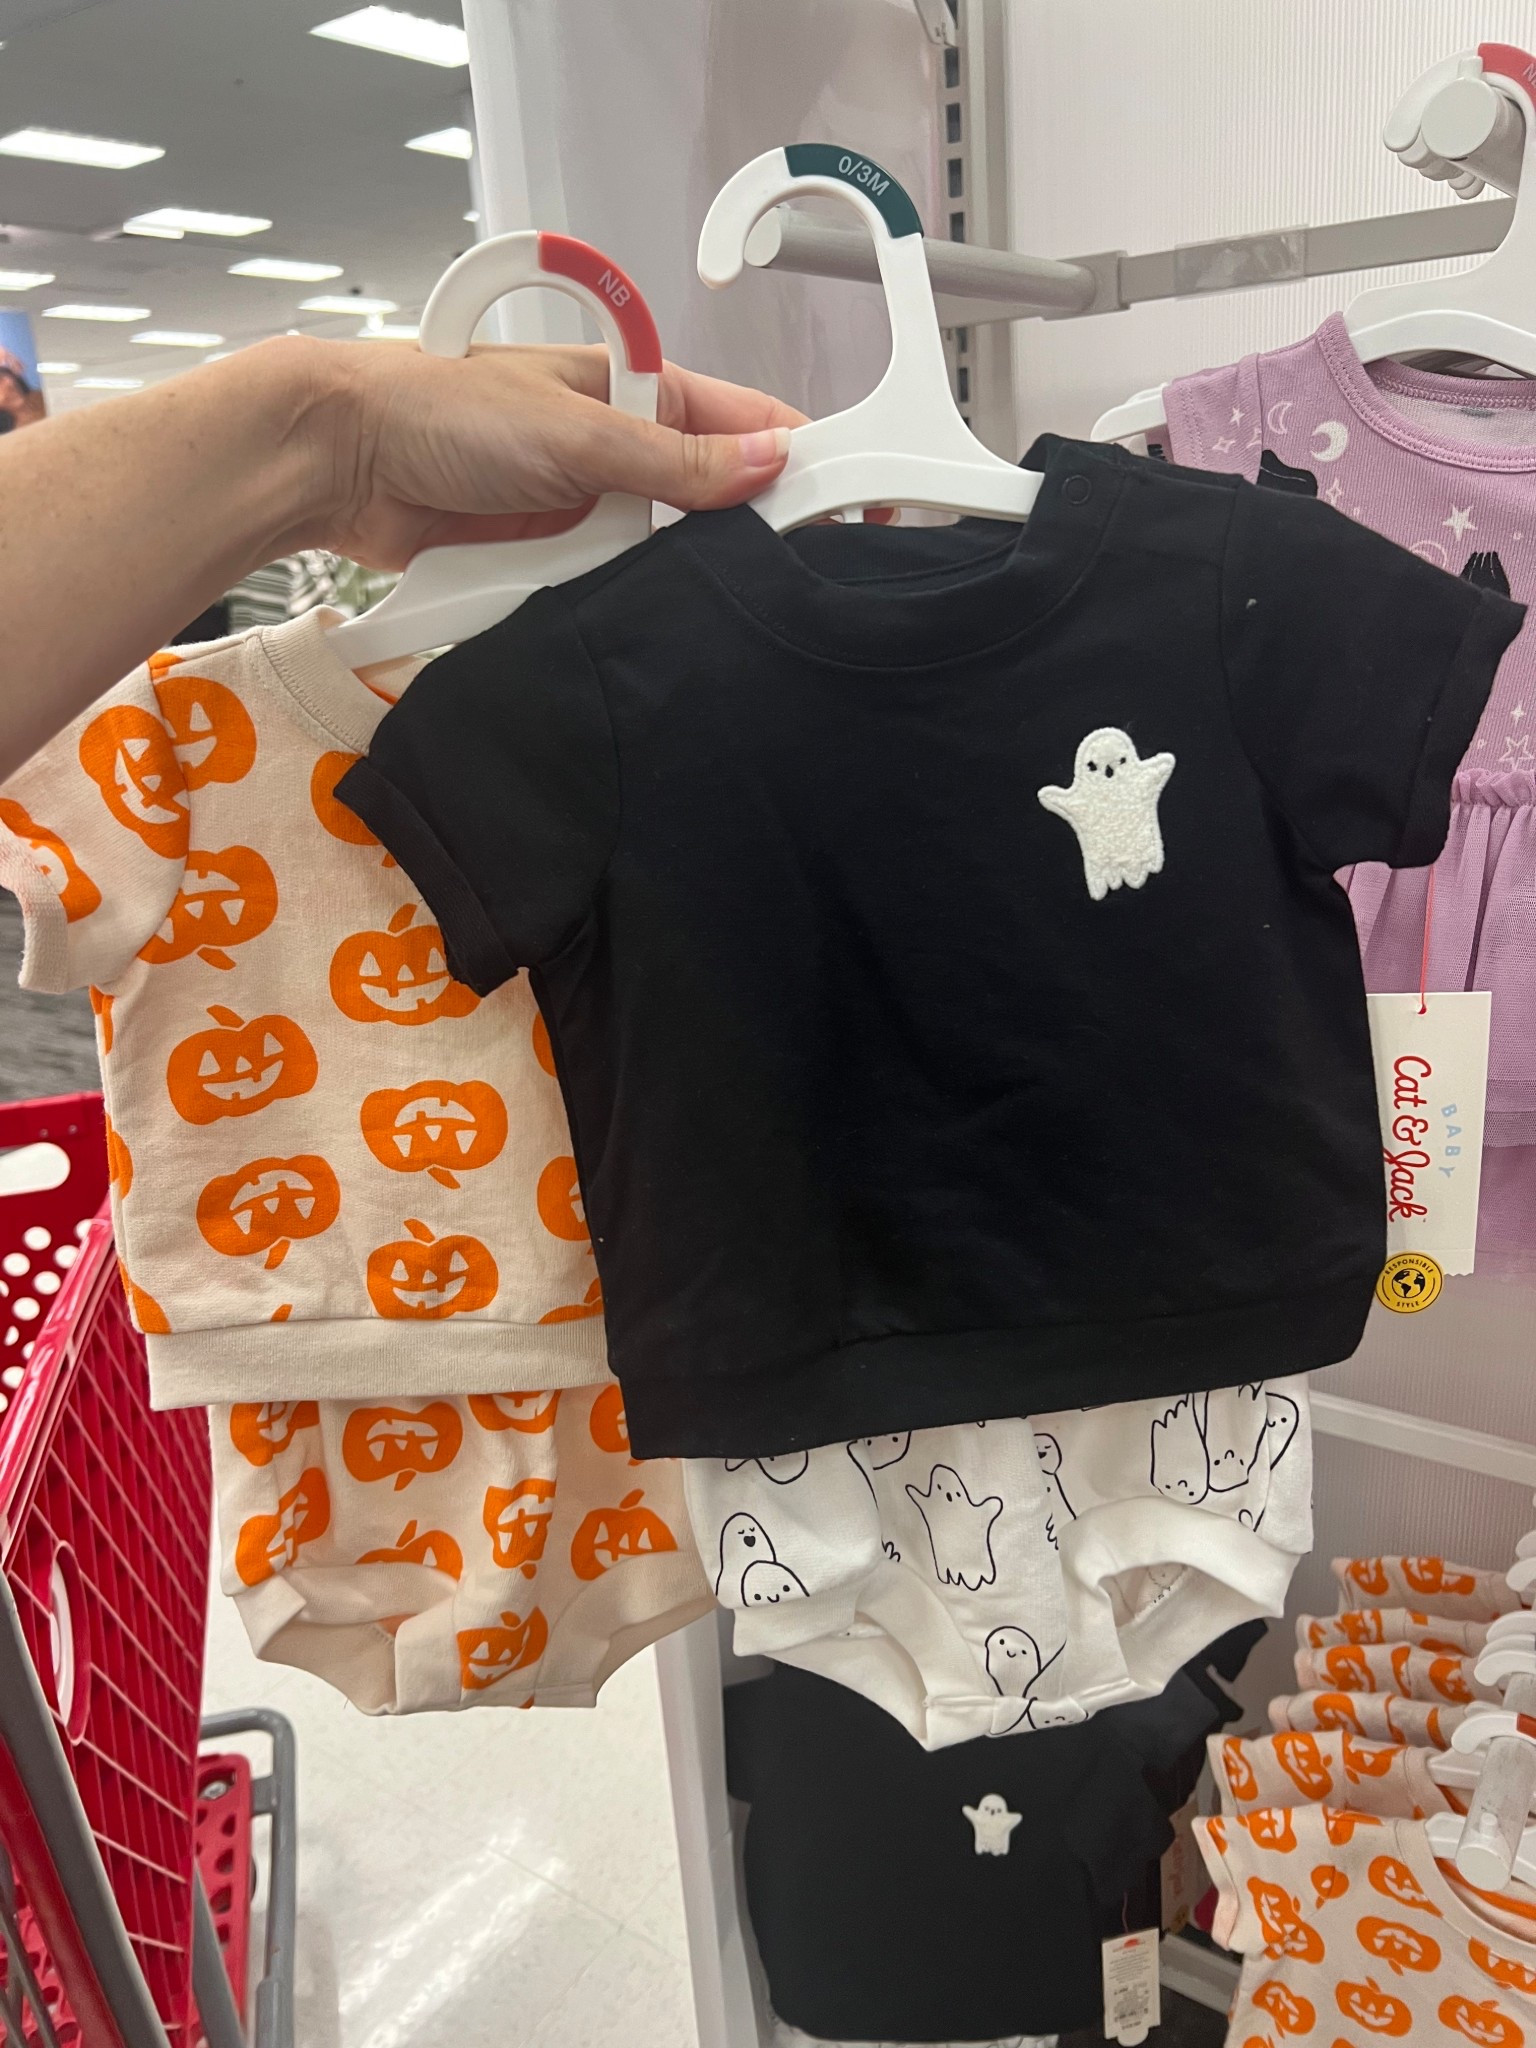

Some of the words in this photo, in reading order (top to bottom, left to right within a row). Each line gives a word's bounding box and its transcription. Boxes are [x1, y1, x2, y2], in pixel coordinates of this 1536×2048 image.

[838, 155, 890, 196] 0/3M
[597, 269, 631, 307] NB
[1393, 1055, 1432, 1110] Cat
[1392, 1114, 1429, 1147] &
[1439, 1103, 1462, 1178] BABY
[1382, 1146, 1431, 1223] Jack
[1384, 1258, 1434, 1275] RESPONSIBLE
[1396, 1300, 1420, 1308] STYLE
